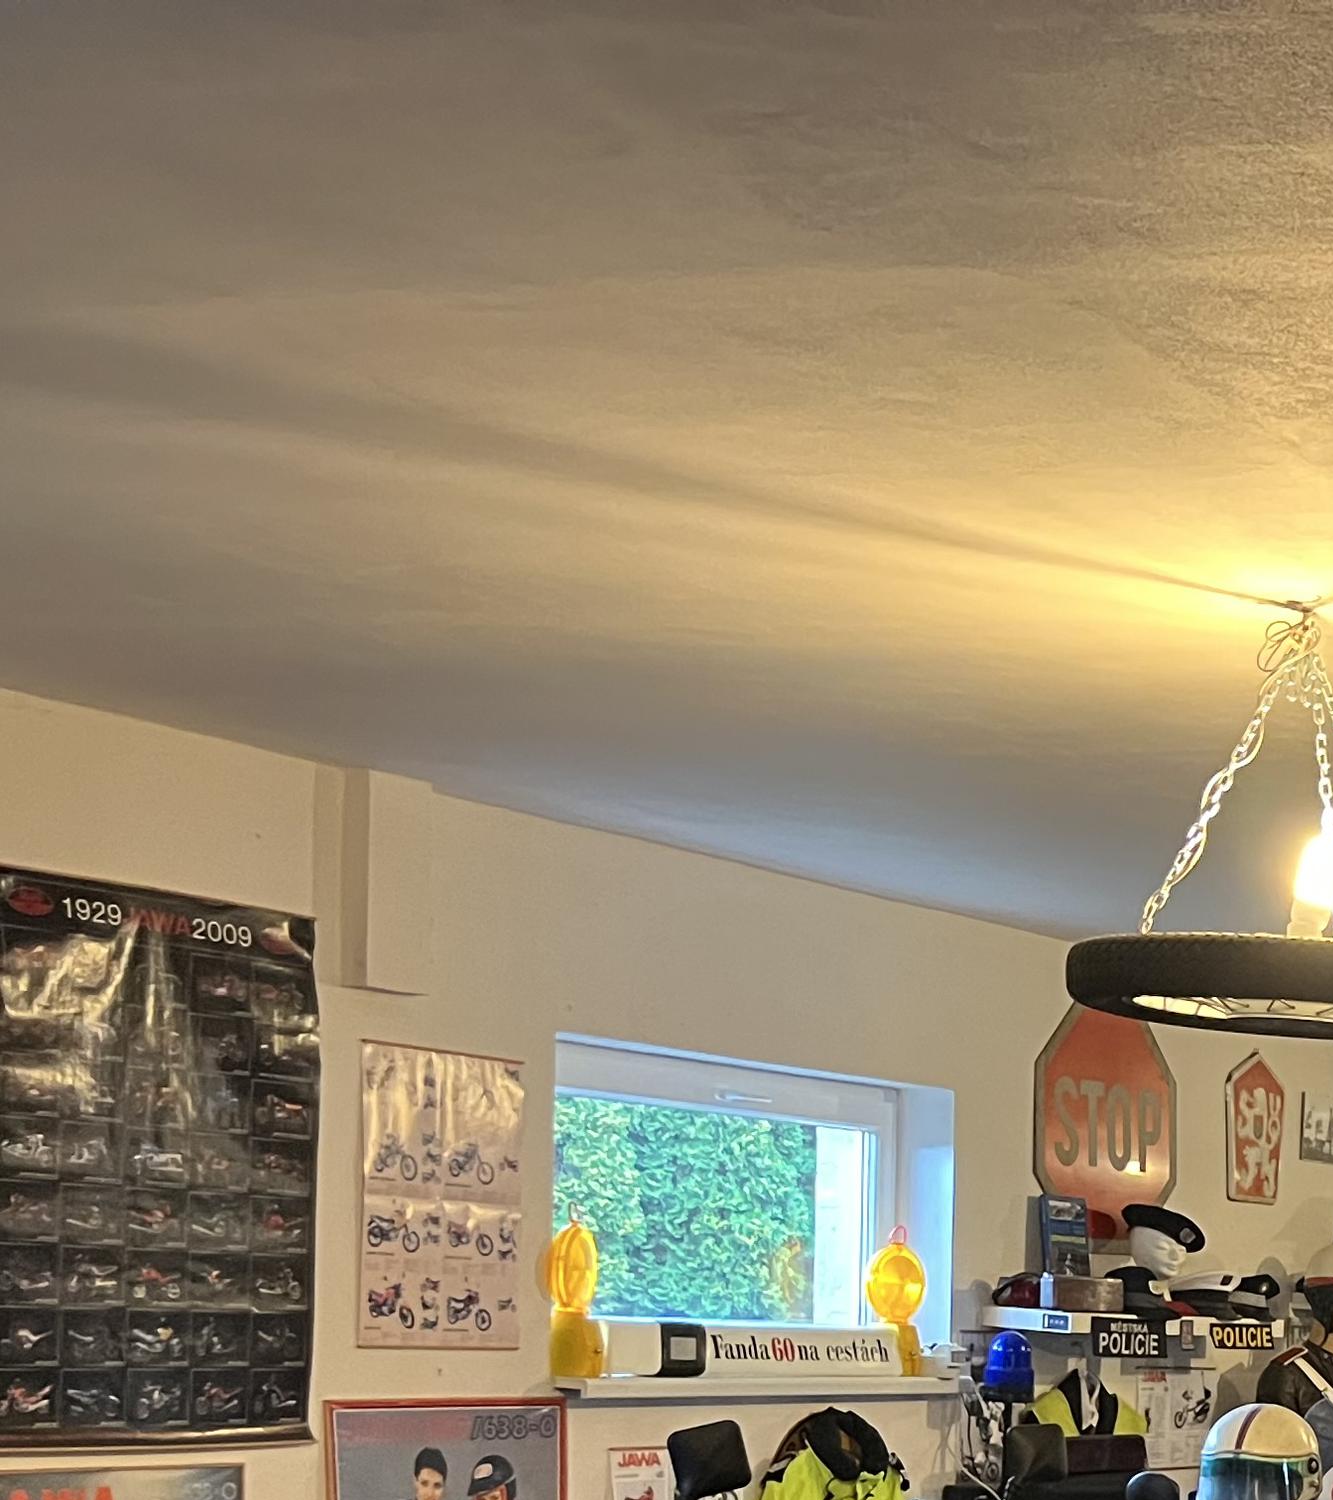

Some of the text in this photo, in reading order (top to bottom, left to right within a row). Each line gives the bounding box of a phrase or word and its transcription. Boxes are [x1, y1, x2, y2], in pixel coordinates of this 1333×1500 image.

[61, 896, 122, 926] 1929
[191, 918, 252, 947] 2009
[1053, 1075, 1162, 1174] STOP
[1110, 1319, 1149, 1333] MĚSTSKÁ
[1212, 1325, 1274, 1349] POLICIE
[710, 1334, 890, 1363] Fanda 60 na cestách
[1098, 1331, 1160, 1356] POLICIE
[618, 1451, 662, 1468] JAWA
